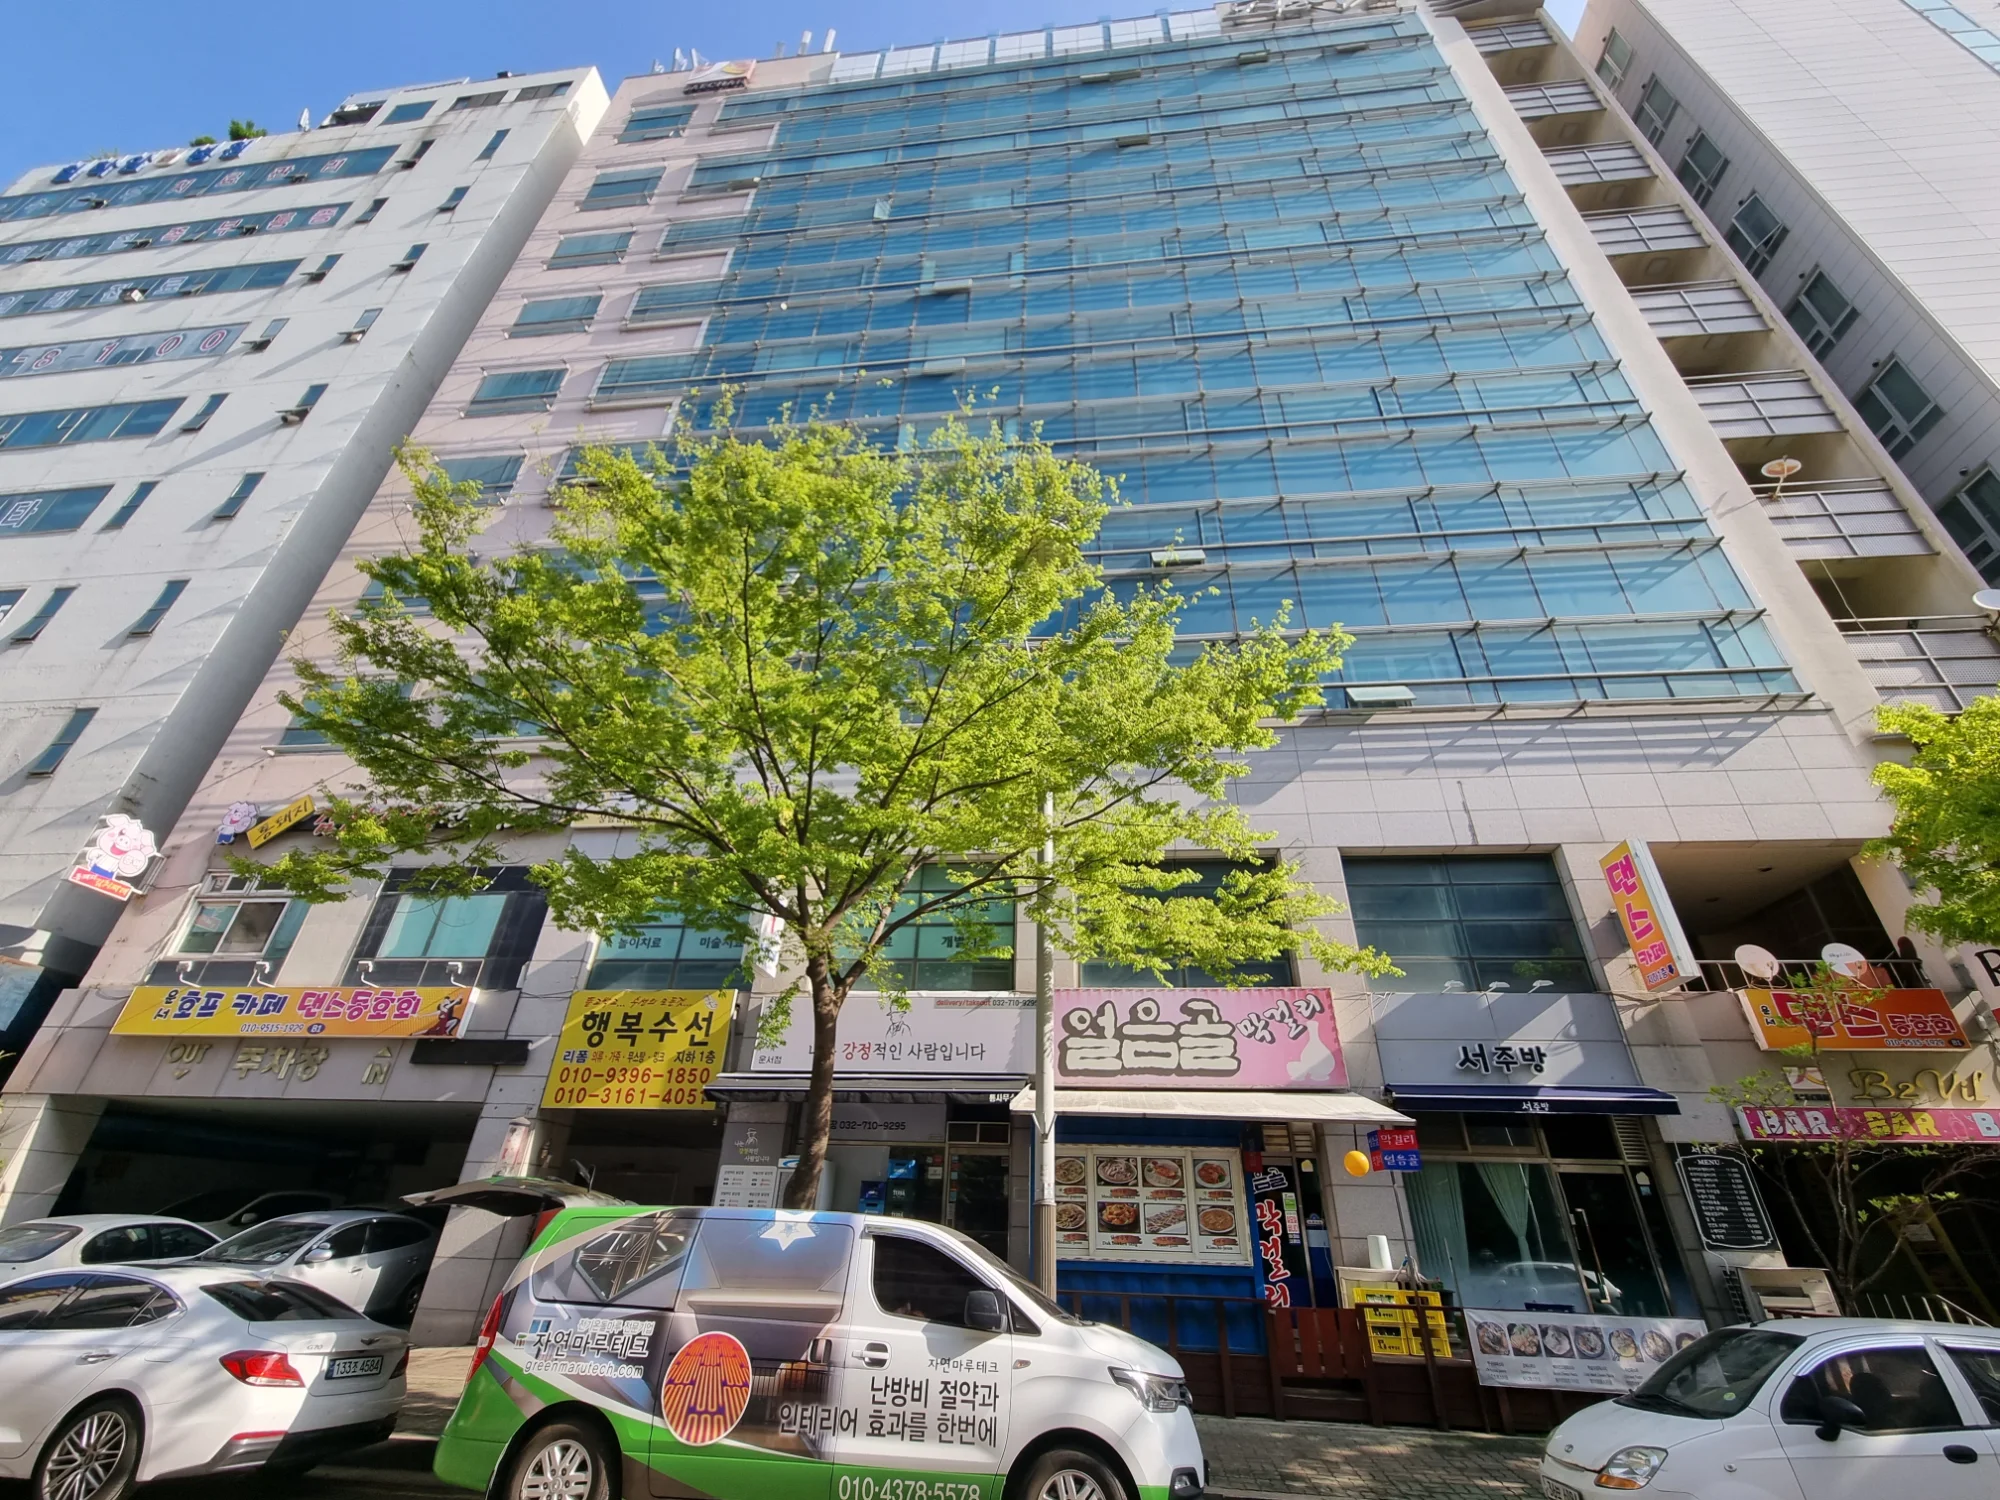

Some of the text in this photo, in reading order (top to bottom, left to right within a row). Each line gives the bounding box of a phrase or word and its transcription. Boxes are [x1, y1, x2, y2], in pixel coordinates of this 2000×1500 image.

[1605, 853, 1654, 941] 댄스
[618, 936, 662, 949] 놀이치료
[1637, 940, 1668, 967] 카페
[172, 989, 423, 1021] 호프 카페 댄스동호회
[935, 999, 991, 1009] delivery/takeout
[240, 1023, 323, 1033] 010-9515-1929 B1
[581, 1010, 714, 1048] 행복수선
[1058, 993, 1325, 1077] 얼음골 막걸리
[1886, 1013, 1957, 1036] 동호회
[166, 1043, 213, 1064] OUT
[563, 1050, 588, 1064] 리폼
[674, 1051, 696, 1064] 지하
[699, 1051, 716, 1064] 1층
[758, 1055, 782, 1065] 운서점
[843, 1041, 902, 1061] 강정적인
[907, 1043, 987, 1062] 사람입니다
[1456, 1041, 1549, 1075] 서주방
[231, 1045, 330, 1082] 주차장
[360, 1061, 392, 1085] IN
[559, 1066, 711, 1085] 010-9396-1850
[1521, 1100, 1550, 1113] 서주방
[839, 1120, 907, 1131] 032-710-9295
[1757, 1110, 1831, 1135] BAR
[1863, 1111, 1942, 1137] BAR
[1380, 1134, 1415, 1146] 막걸리
[1255, 1199, 1292, 1309] 막걸리
[623, 1321, 655, 1335] 전문기업
[533, 1330, 649, 1358] 자연마루테크
[359, 1359, 379, 1373] 4584
[525, 1360, 643, 1379] greenmarutech.com
[928, 1358, 999, 1374] 자연마루테크
[870, 1375, 999, 1413] 난방비 절약과
[779, 1403, 997, 1448] 인테리어 효과를 한번에
